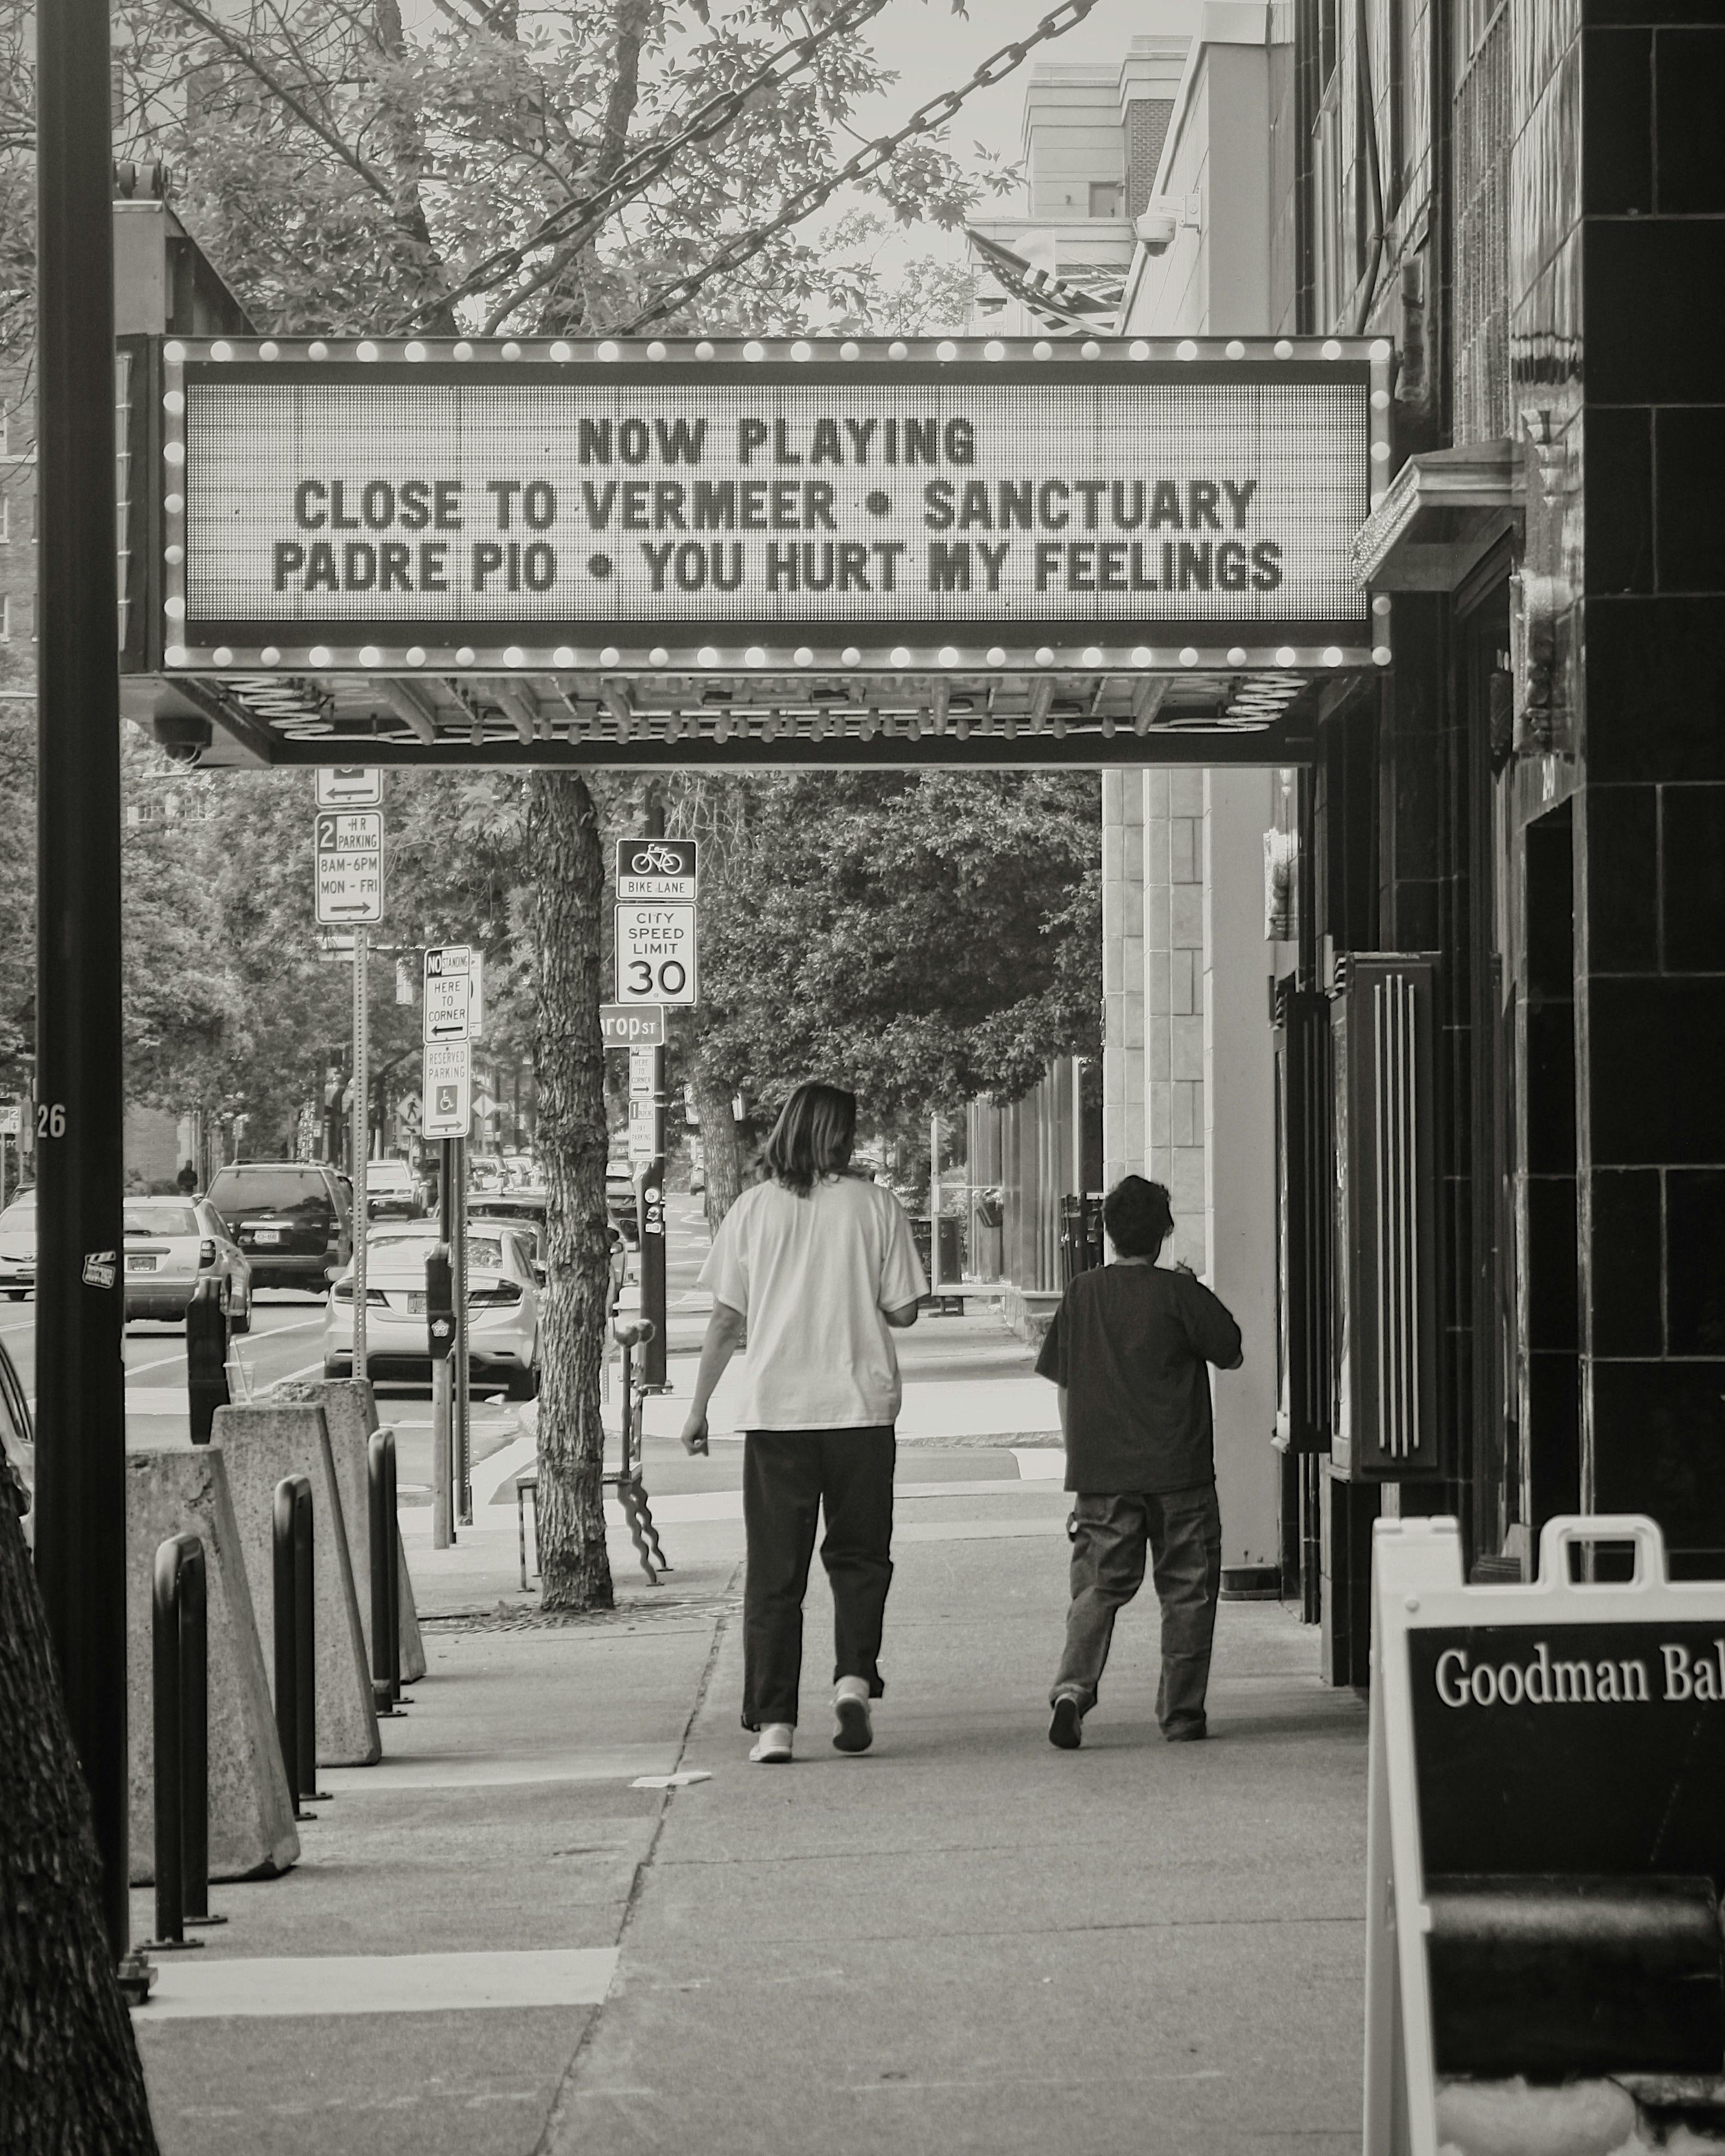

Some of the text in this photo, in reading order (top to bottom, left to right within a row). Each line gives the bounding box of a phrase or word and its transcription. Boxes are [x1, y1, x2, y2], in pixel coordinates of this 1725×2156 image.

[579, 419, 974, 464] NOW PLAYING
[295, 481, 1257, 529] CLOSE TO VERMEER SANCTUARY
[274, 541, 1283, 591] PADRE PIO YOU HURT MY FEELINGS
[320, 818, 366, 848] 2 HR
[339, 835, 377, 848] PARKING
[321, 857, 377, 872] 8AM-6PM
[321, 880, 345, 894] MON
[360, 879, 377, 893] FRI
[628, 881, 685, 893] BIKE LANE
[637, 912, 675, 924] CITY
[628, 928, 684, 939] SPEED
[634, 944, 678, 954] LIMIT
[428, 955, 442, 974] NO
[443, 956, 468, 969] STANDING
[627, 960, 686, 996] 30
[435, 981, 461, 994] HERE
[442, 996, 454, 1007] TO
[429, 1009, 466, 1022] CORNER
[642, 1022, 656, 1034] ST
[430, 1050, 464, 1065] RESERVED
[429, 1067, 465, 1081] PARKING
[37, 1104, 66, 1138] 26
[1435, 1641, 1650, 1708] Goodman
